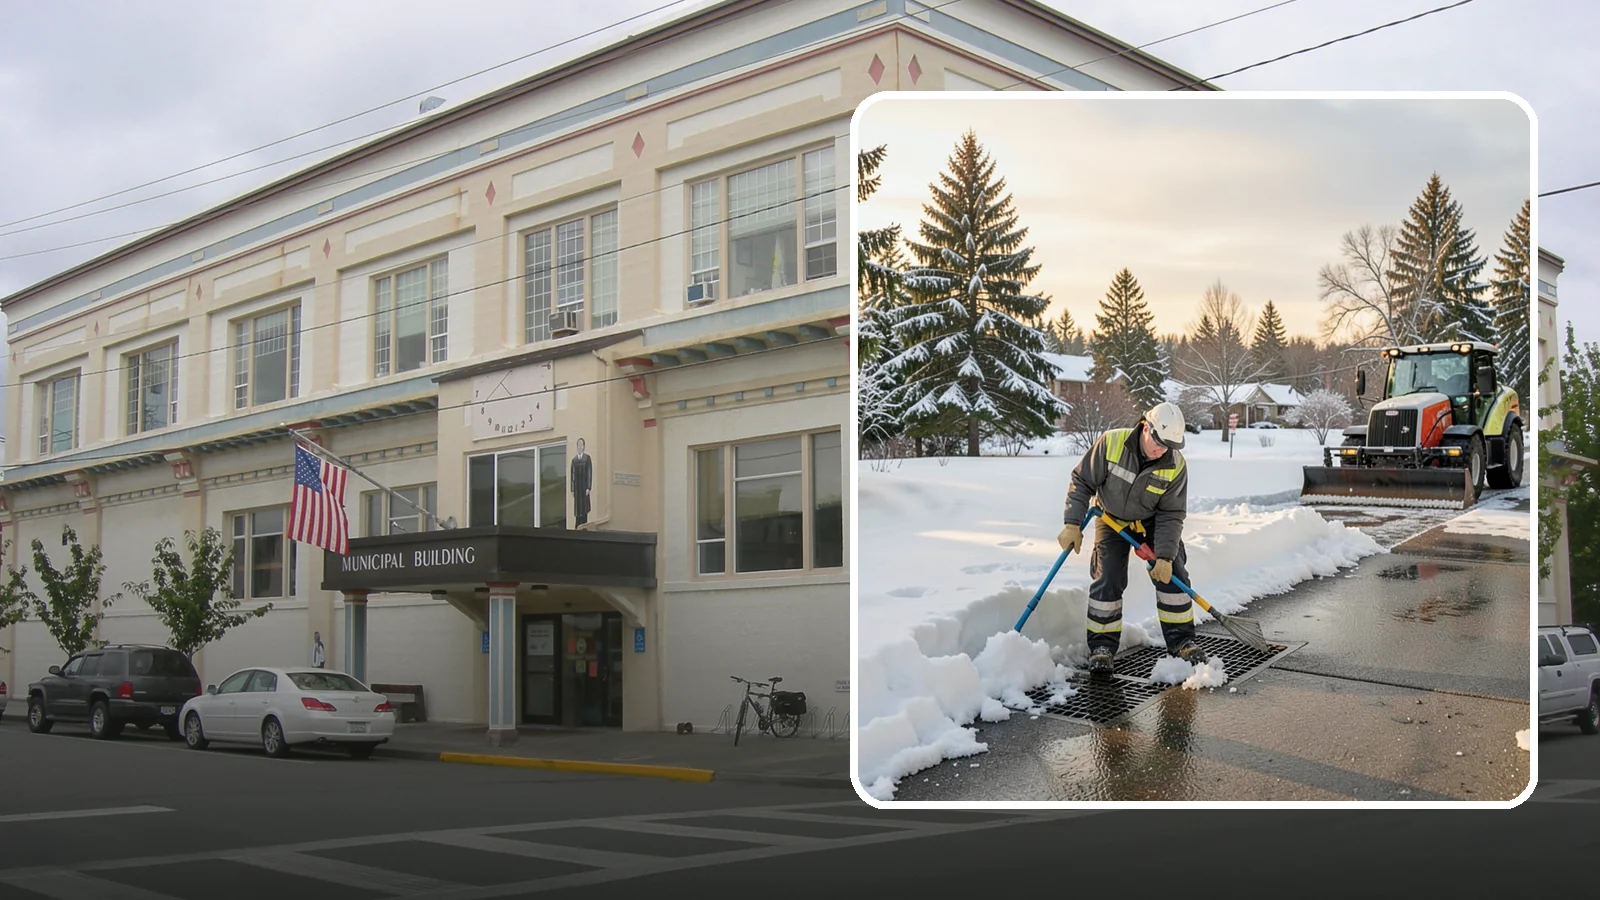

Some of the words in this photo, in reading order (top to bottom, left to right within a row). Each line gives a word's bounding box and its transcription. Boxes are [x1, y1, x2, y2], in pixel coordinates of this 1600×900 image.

[476, 390, 479, 398] 7
[529, 414, 533, 422] 3
[342, 552, 405, 572] MUNICIPAL
[414, 546, 475, 567] BUILDING
